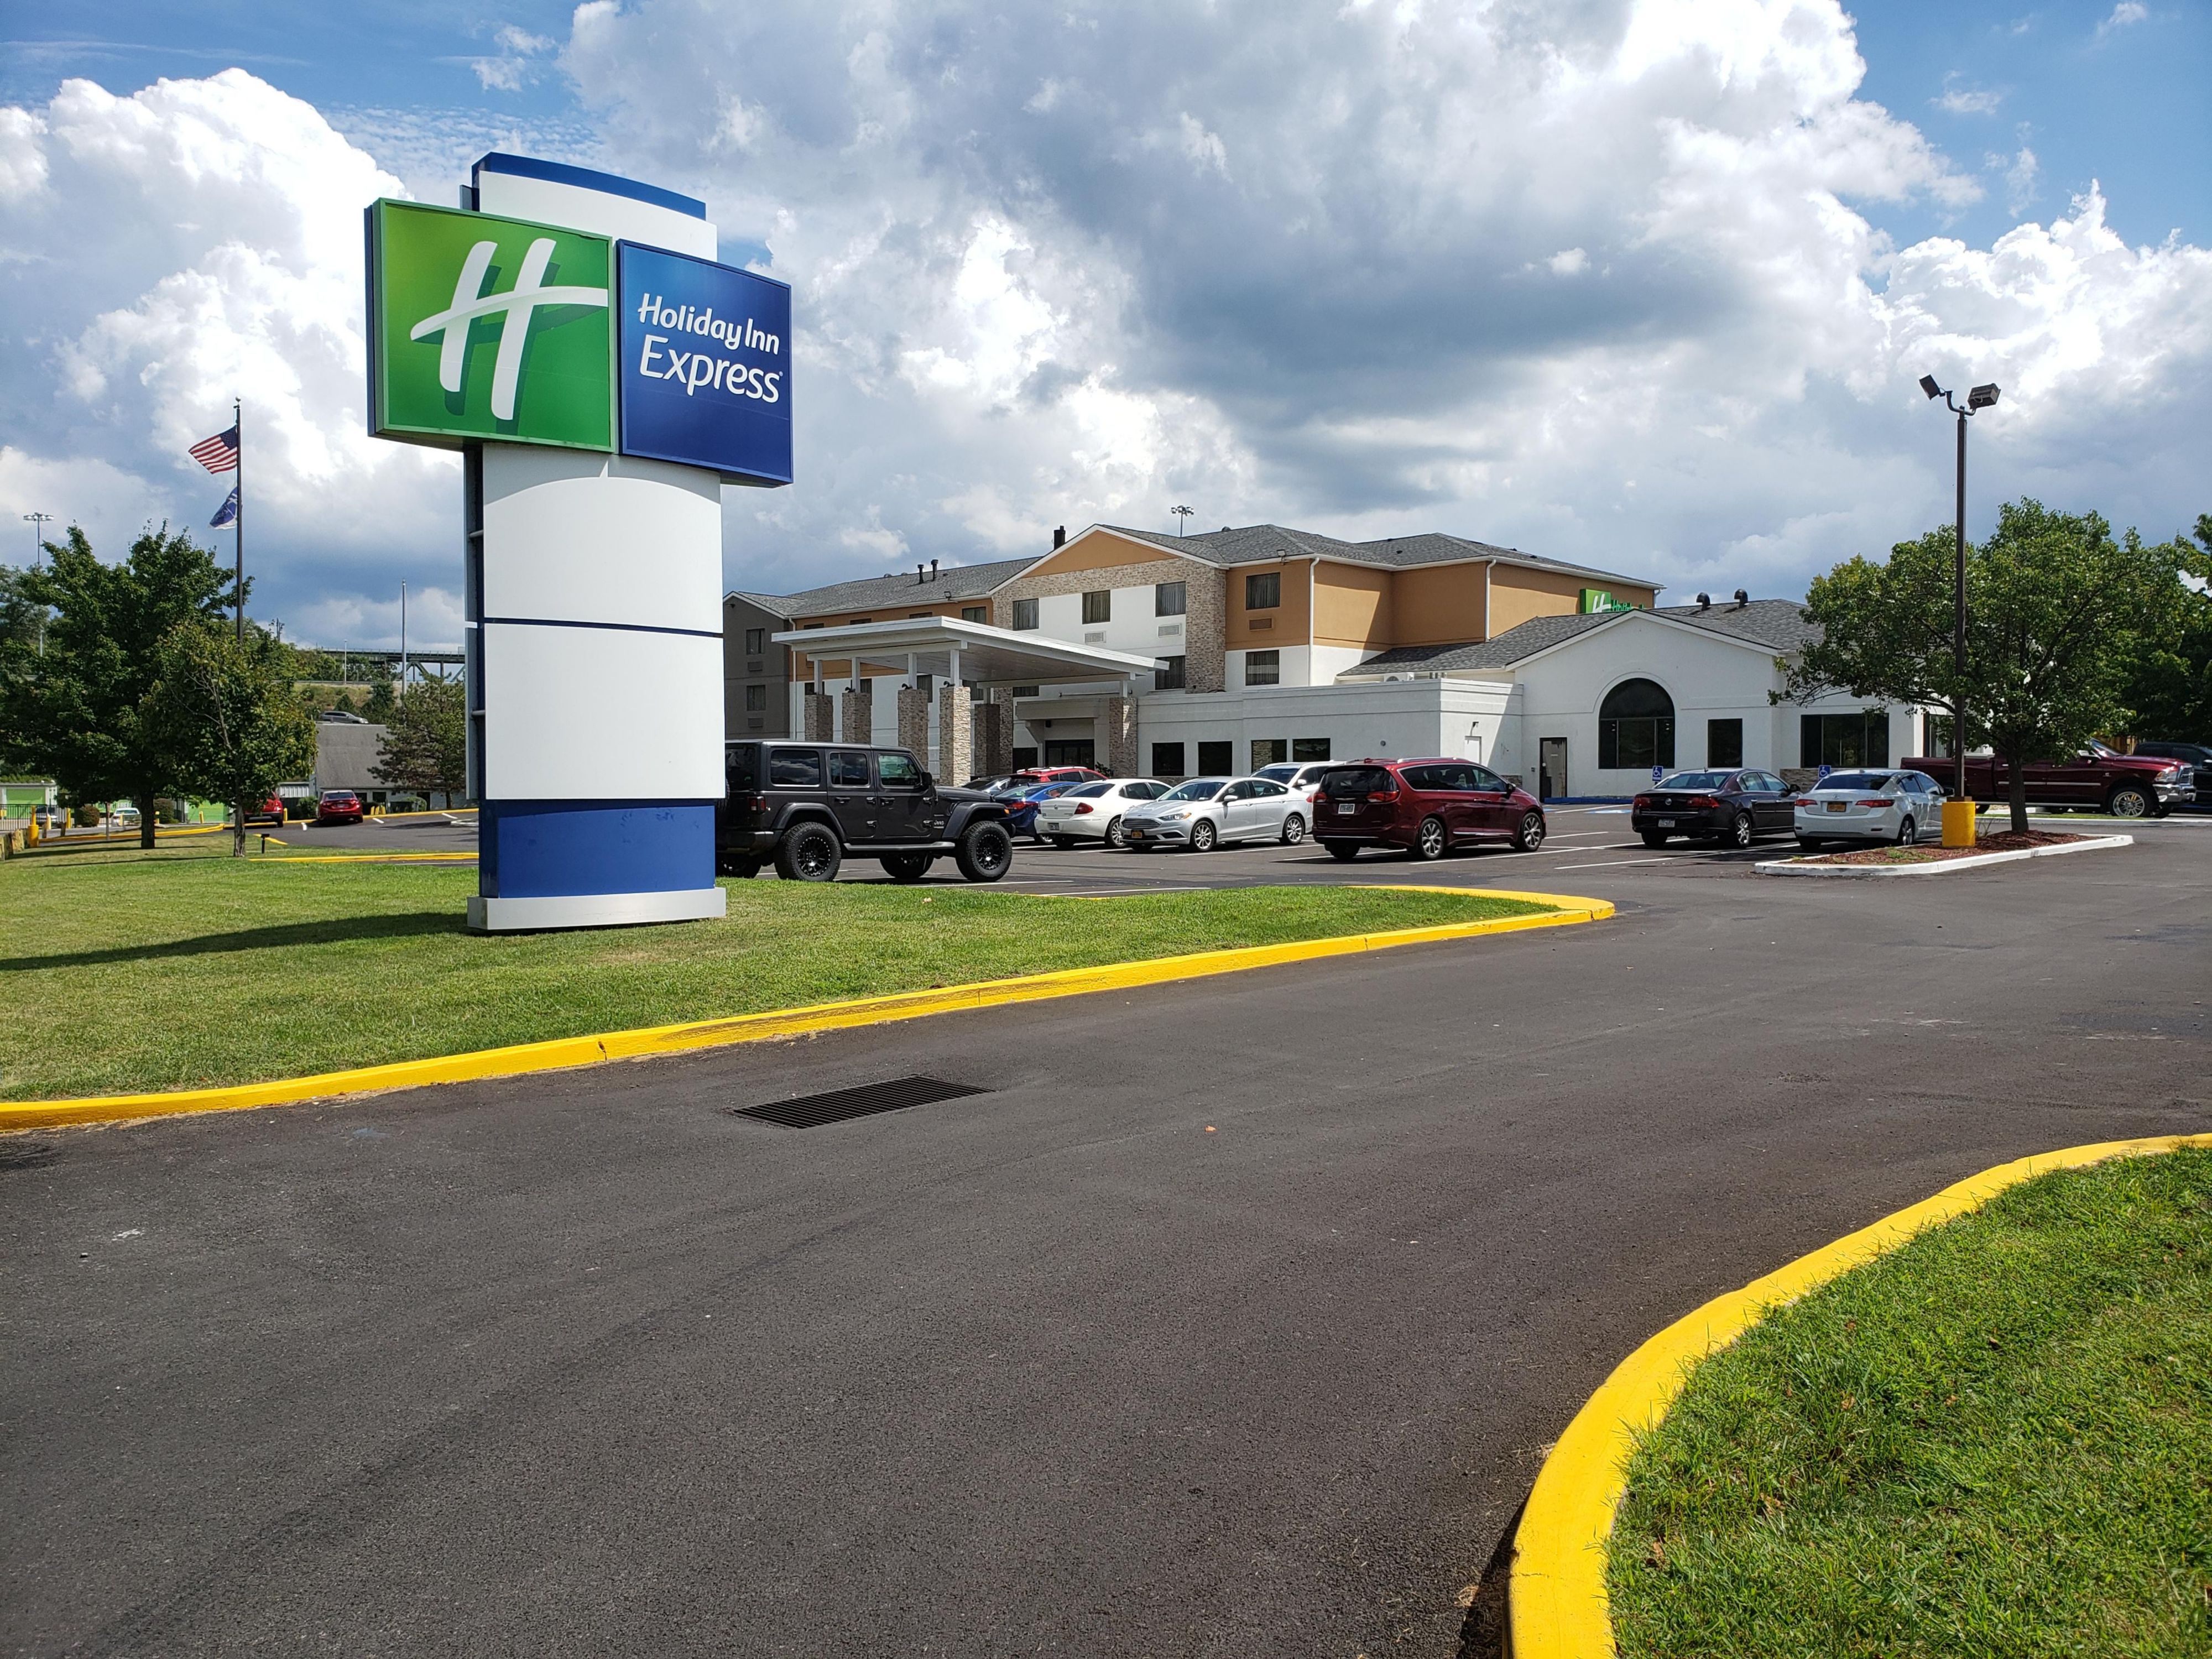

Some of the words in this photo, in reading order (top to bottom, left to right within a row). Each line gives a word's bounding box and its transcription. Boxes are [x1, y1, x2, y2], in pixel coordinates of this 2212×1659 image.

[638, 293, 742, 350] Holiday
[745, 318, 780, 355] Inn
[640, 334, 780, 403] Express
